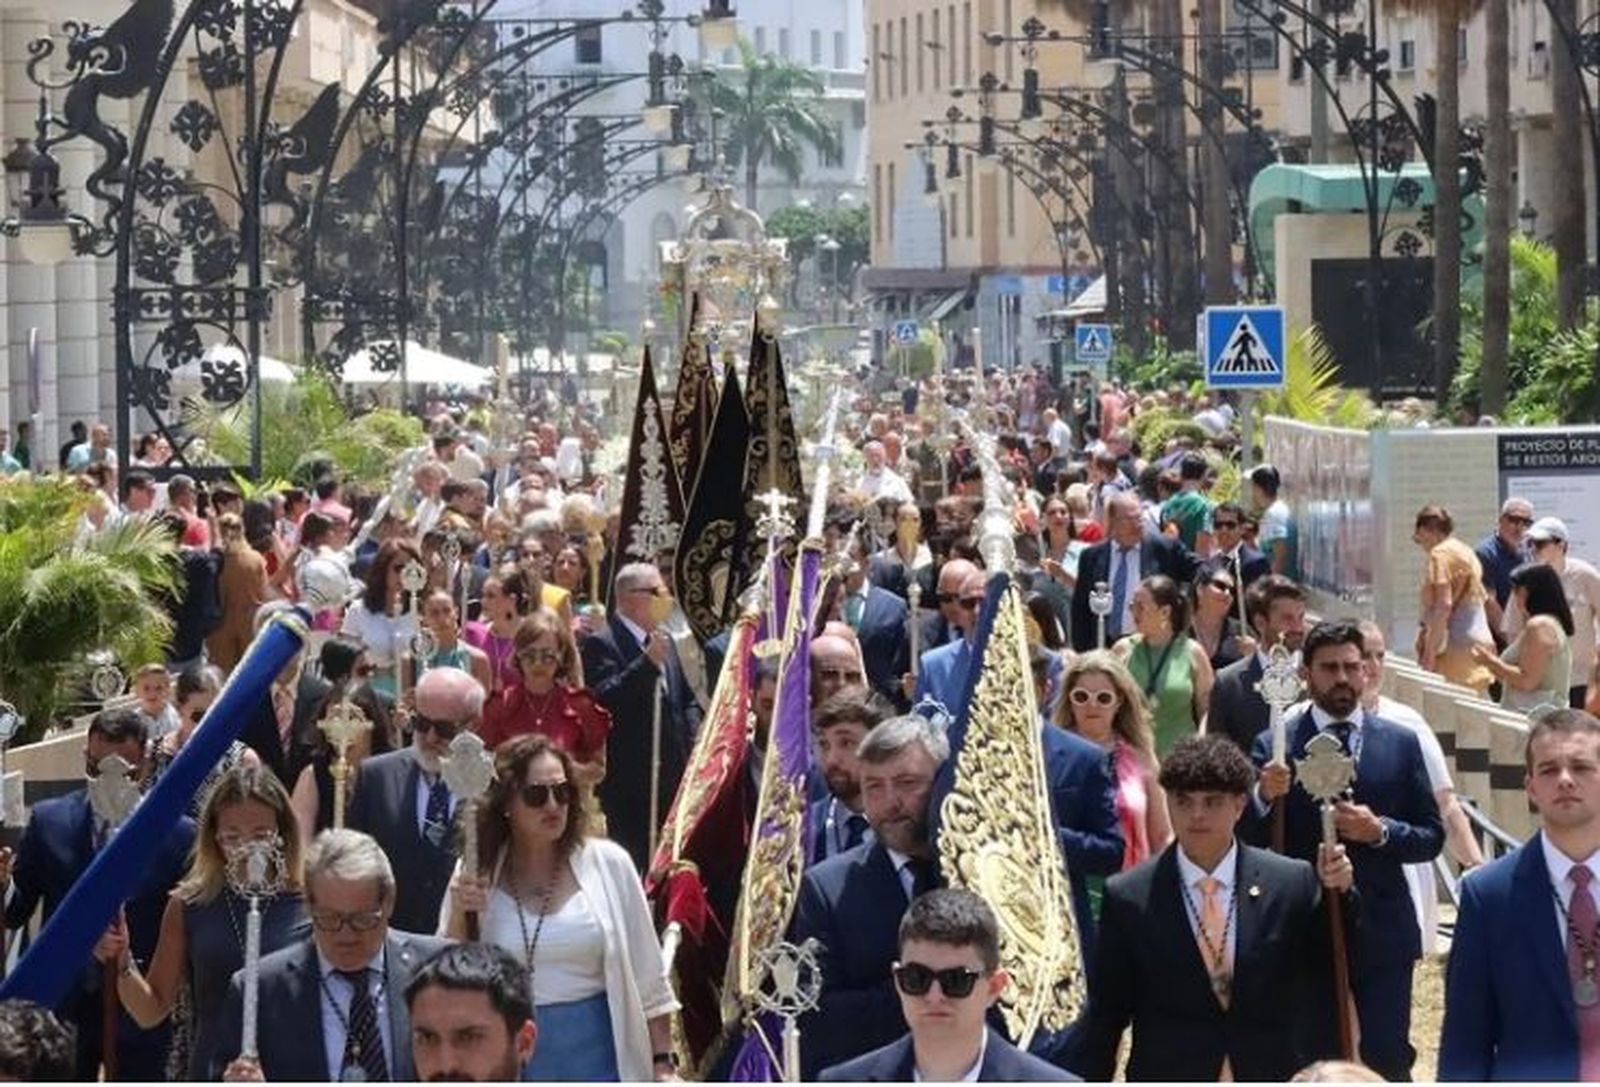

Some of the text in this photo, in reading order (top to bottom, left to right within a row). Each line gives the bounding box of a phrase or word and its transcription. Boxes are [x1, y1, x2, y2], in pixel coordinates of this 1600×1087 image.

[1504, 440, 1567, 452] PROYECTO
[1569, 439, 1585, 451] DE
[1504, 453, 1600, 467] DE RESTOS ARQ
